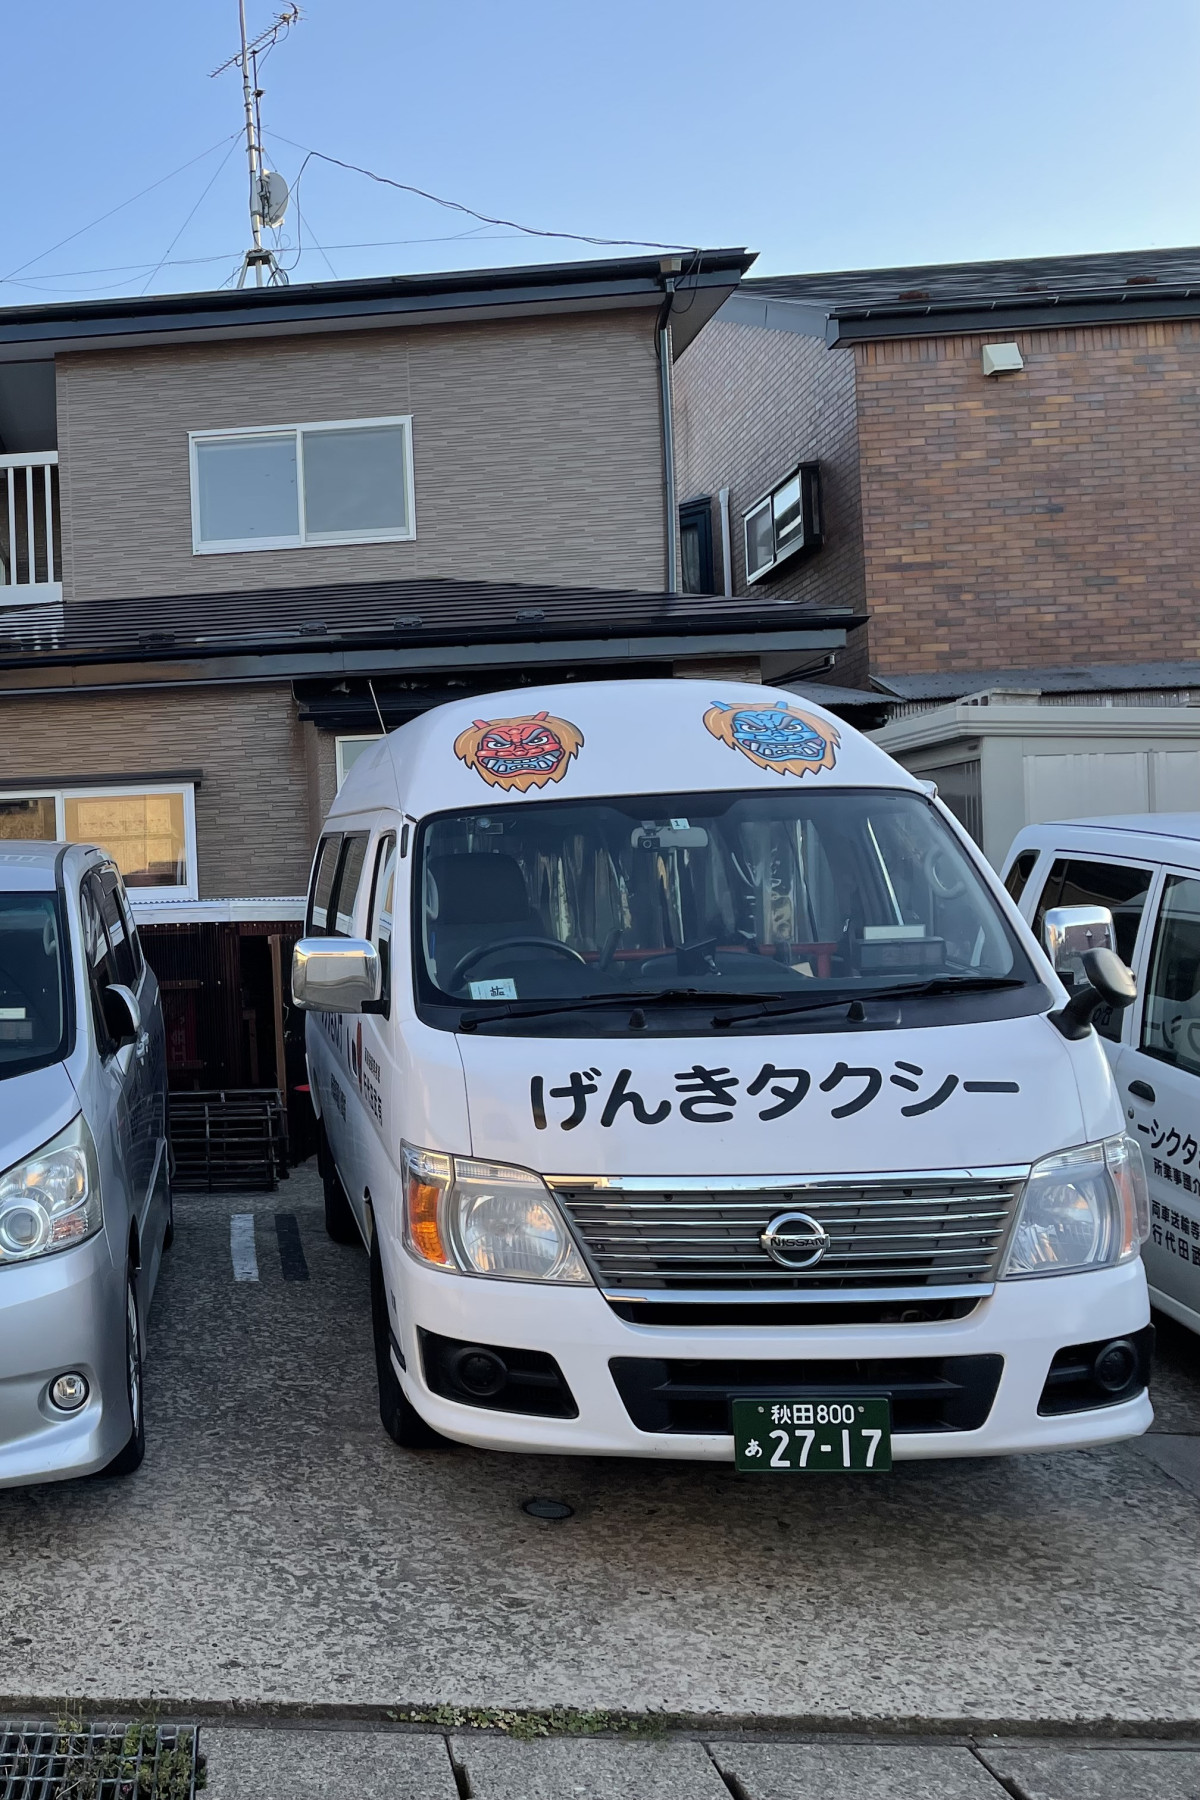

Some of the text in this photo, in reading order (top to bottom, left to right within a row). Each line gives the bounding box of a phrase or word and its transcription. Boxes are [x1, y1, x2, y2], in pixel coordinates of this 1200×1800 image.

[530, 1061, 1020, 1131] げんきタクシー
[770, 1236, 825, 1247] NISSAN
[744, 1429, 882, 1467] あ 27-17
